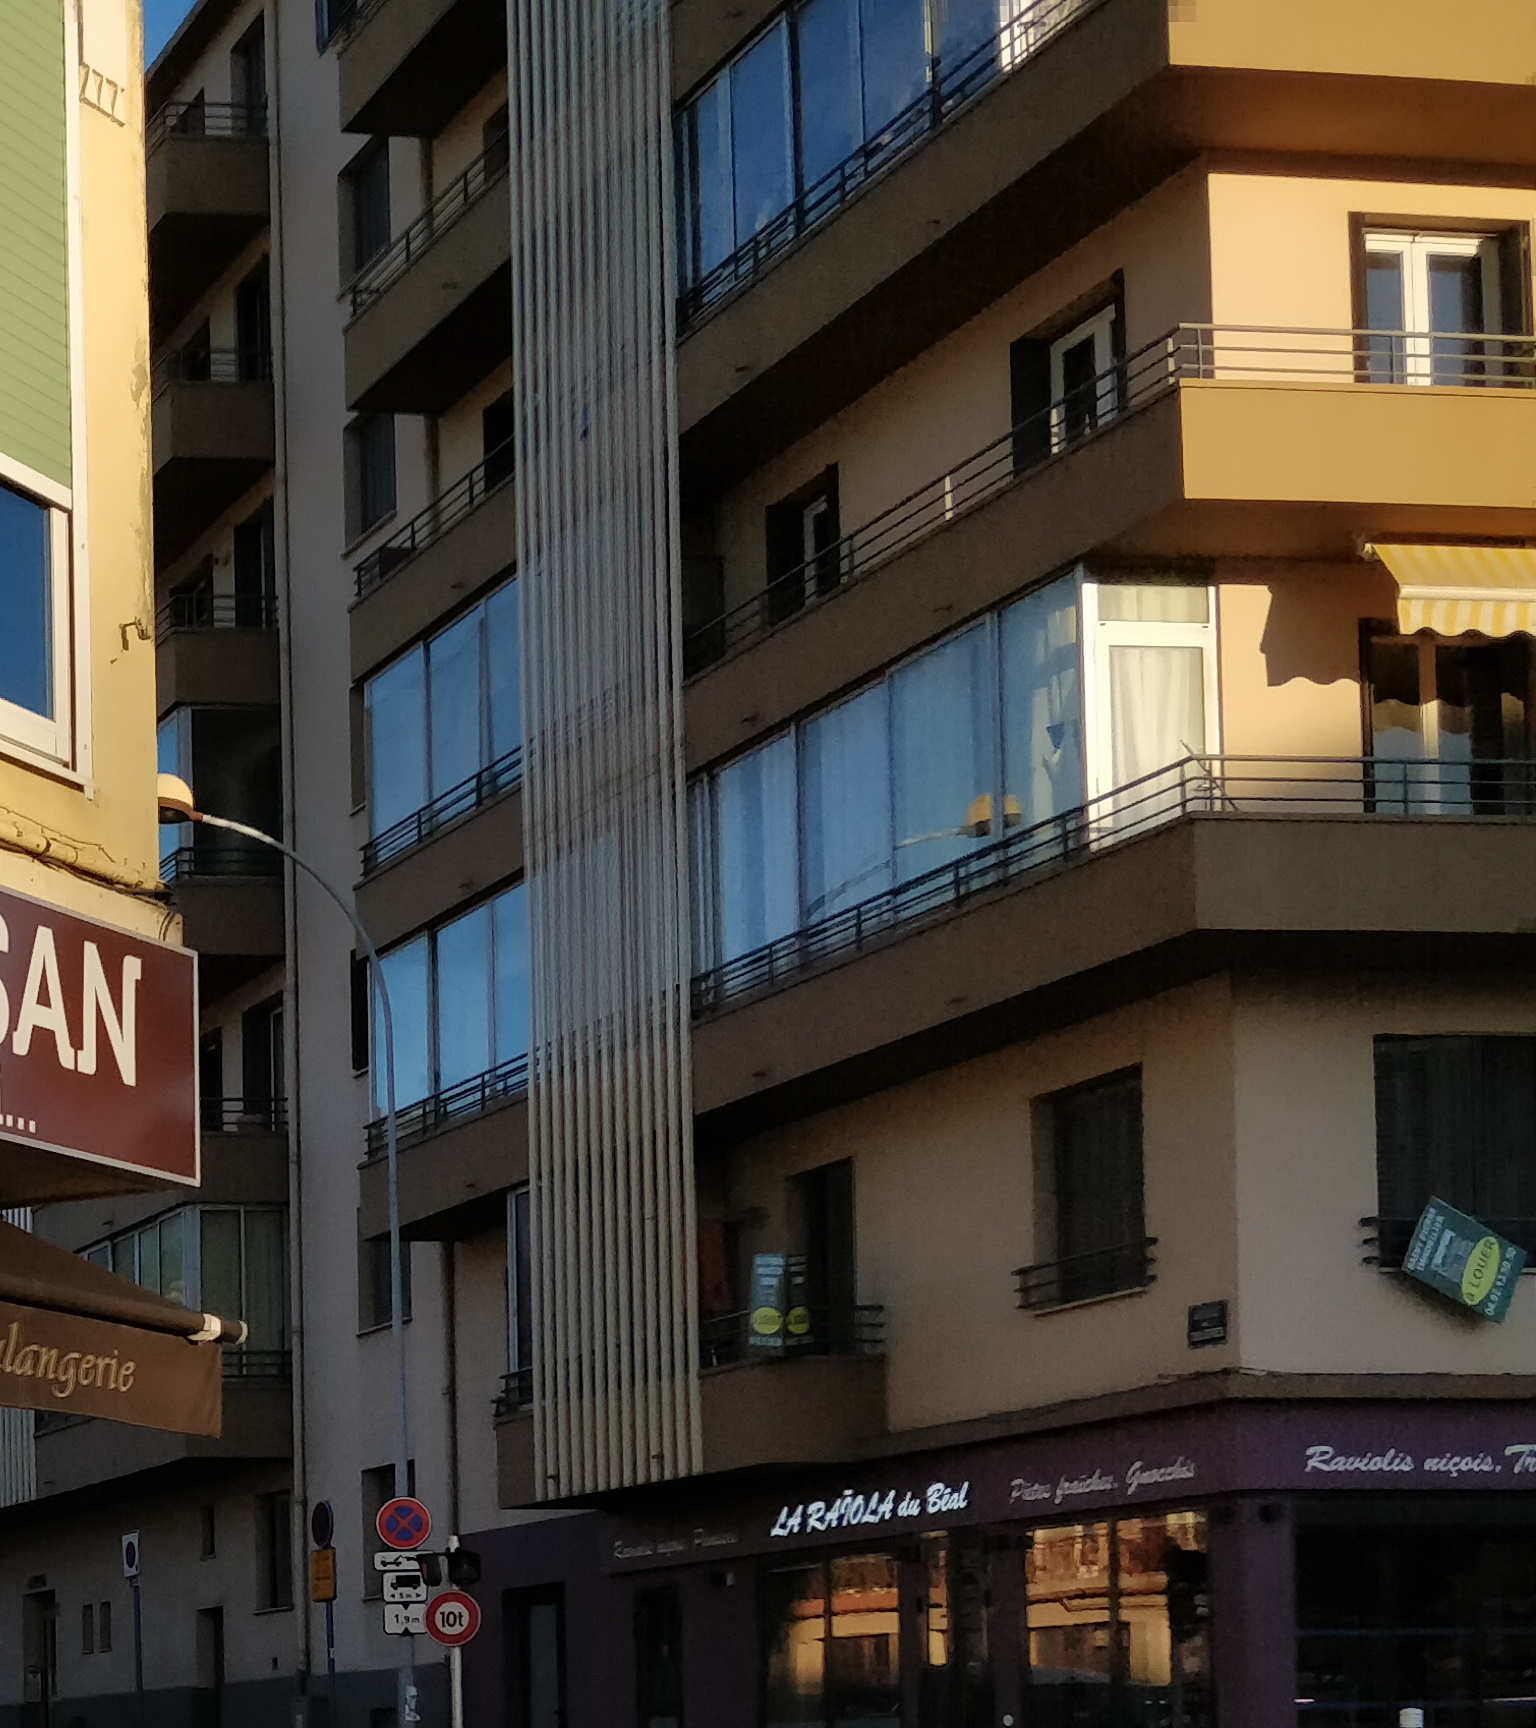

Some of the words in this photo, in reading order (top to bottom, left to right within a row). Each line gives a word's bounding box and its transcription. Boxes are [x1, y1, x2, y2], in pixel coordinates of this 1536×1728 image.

[1469, 1238, 1496, 1288] LOUER
[1305, 1446, 1414, 1472] Raviolis
[770, 1504, 804, 1537] LA
[897, 1491, 921, 1517] du
[439, 1611, 464, 1627] 10t
